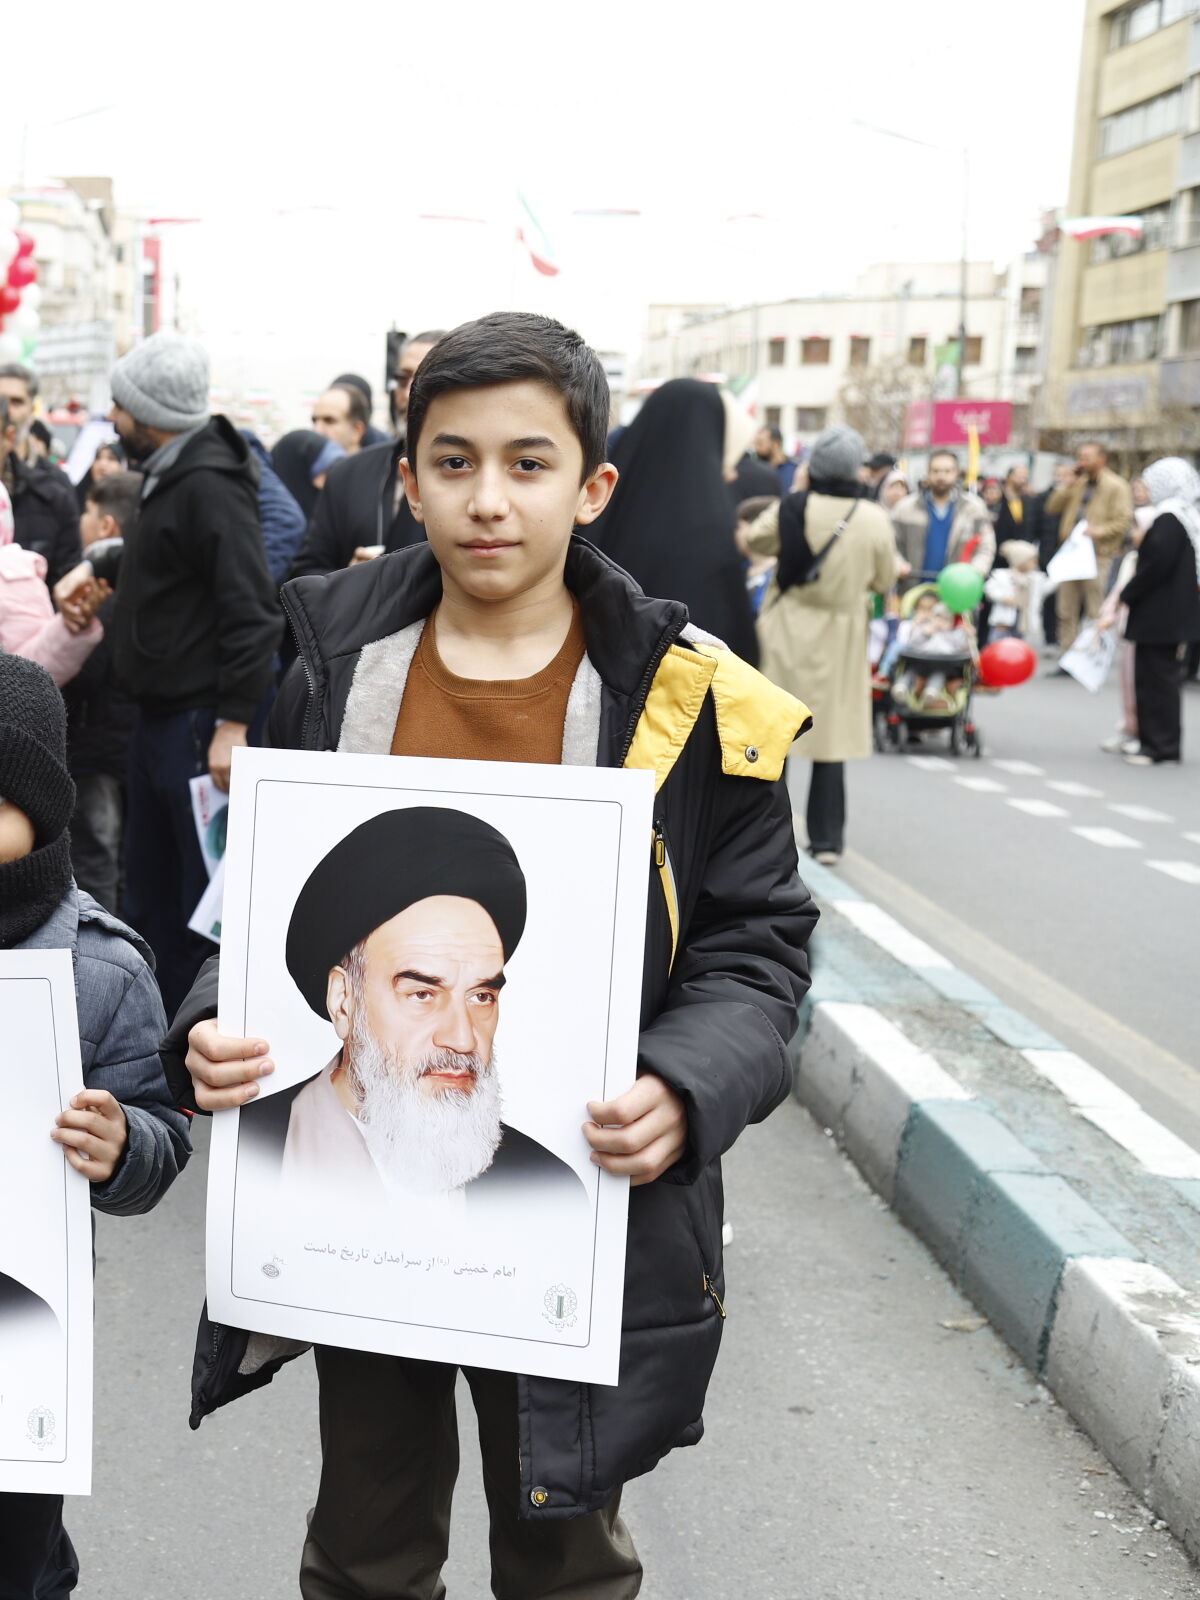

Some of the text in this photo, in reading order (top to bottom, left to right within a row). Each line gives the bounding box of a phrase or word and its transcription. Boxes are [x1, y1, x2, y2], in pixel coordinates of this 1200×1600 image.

[303, 1241, 337, 1256] ماست
[339, 1245, 370, 1263] تاریخ
[453, 1261, 489, 1276] خمینی
[492, 1264, 516, 1279] امام
